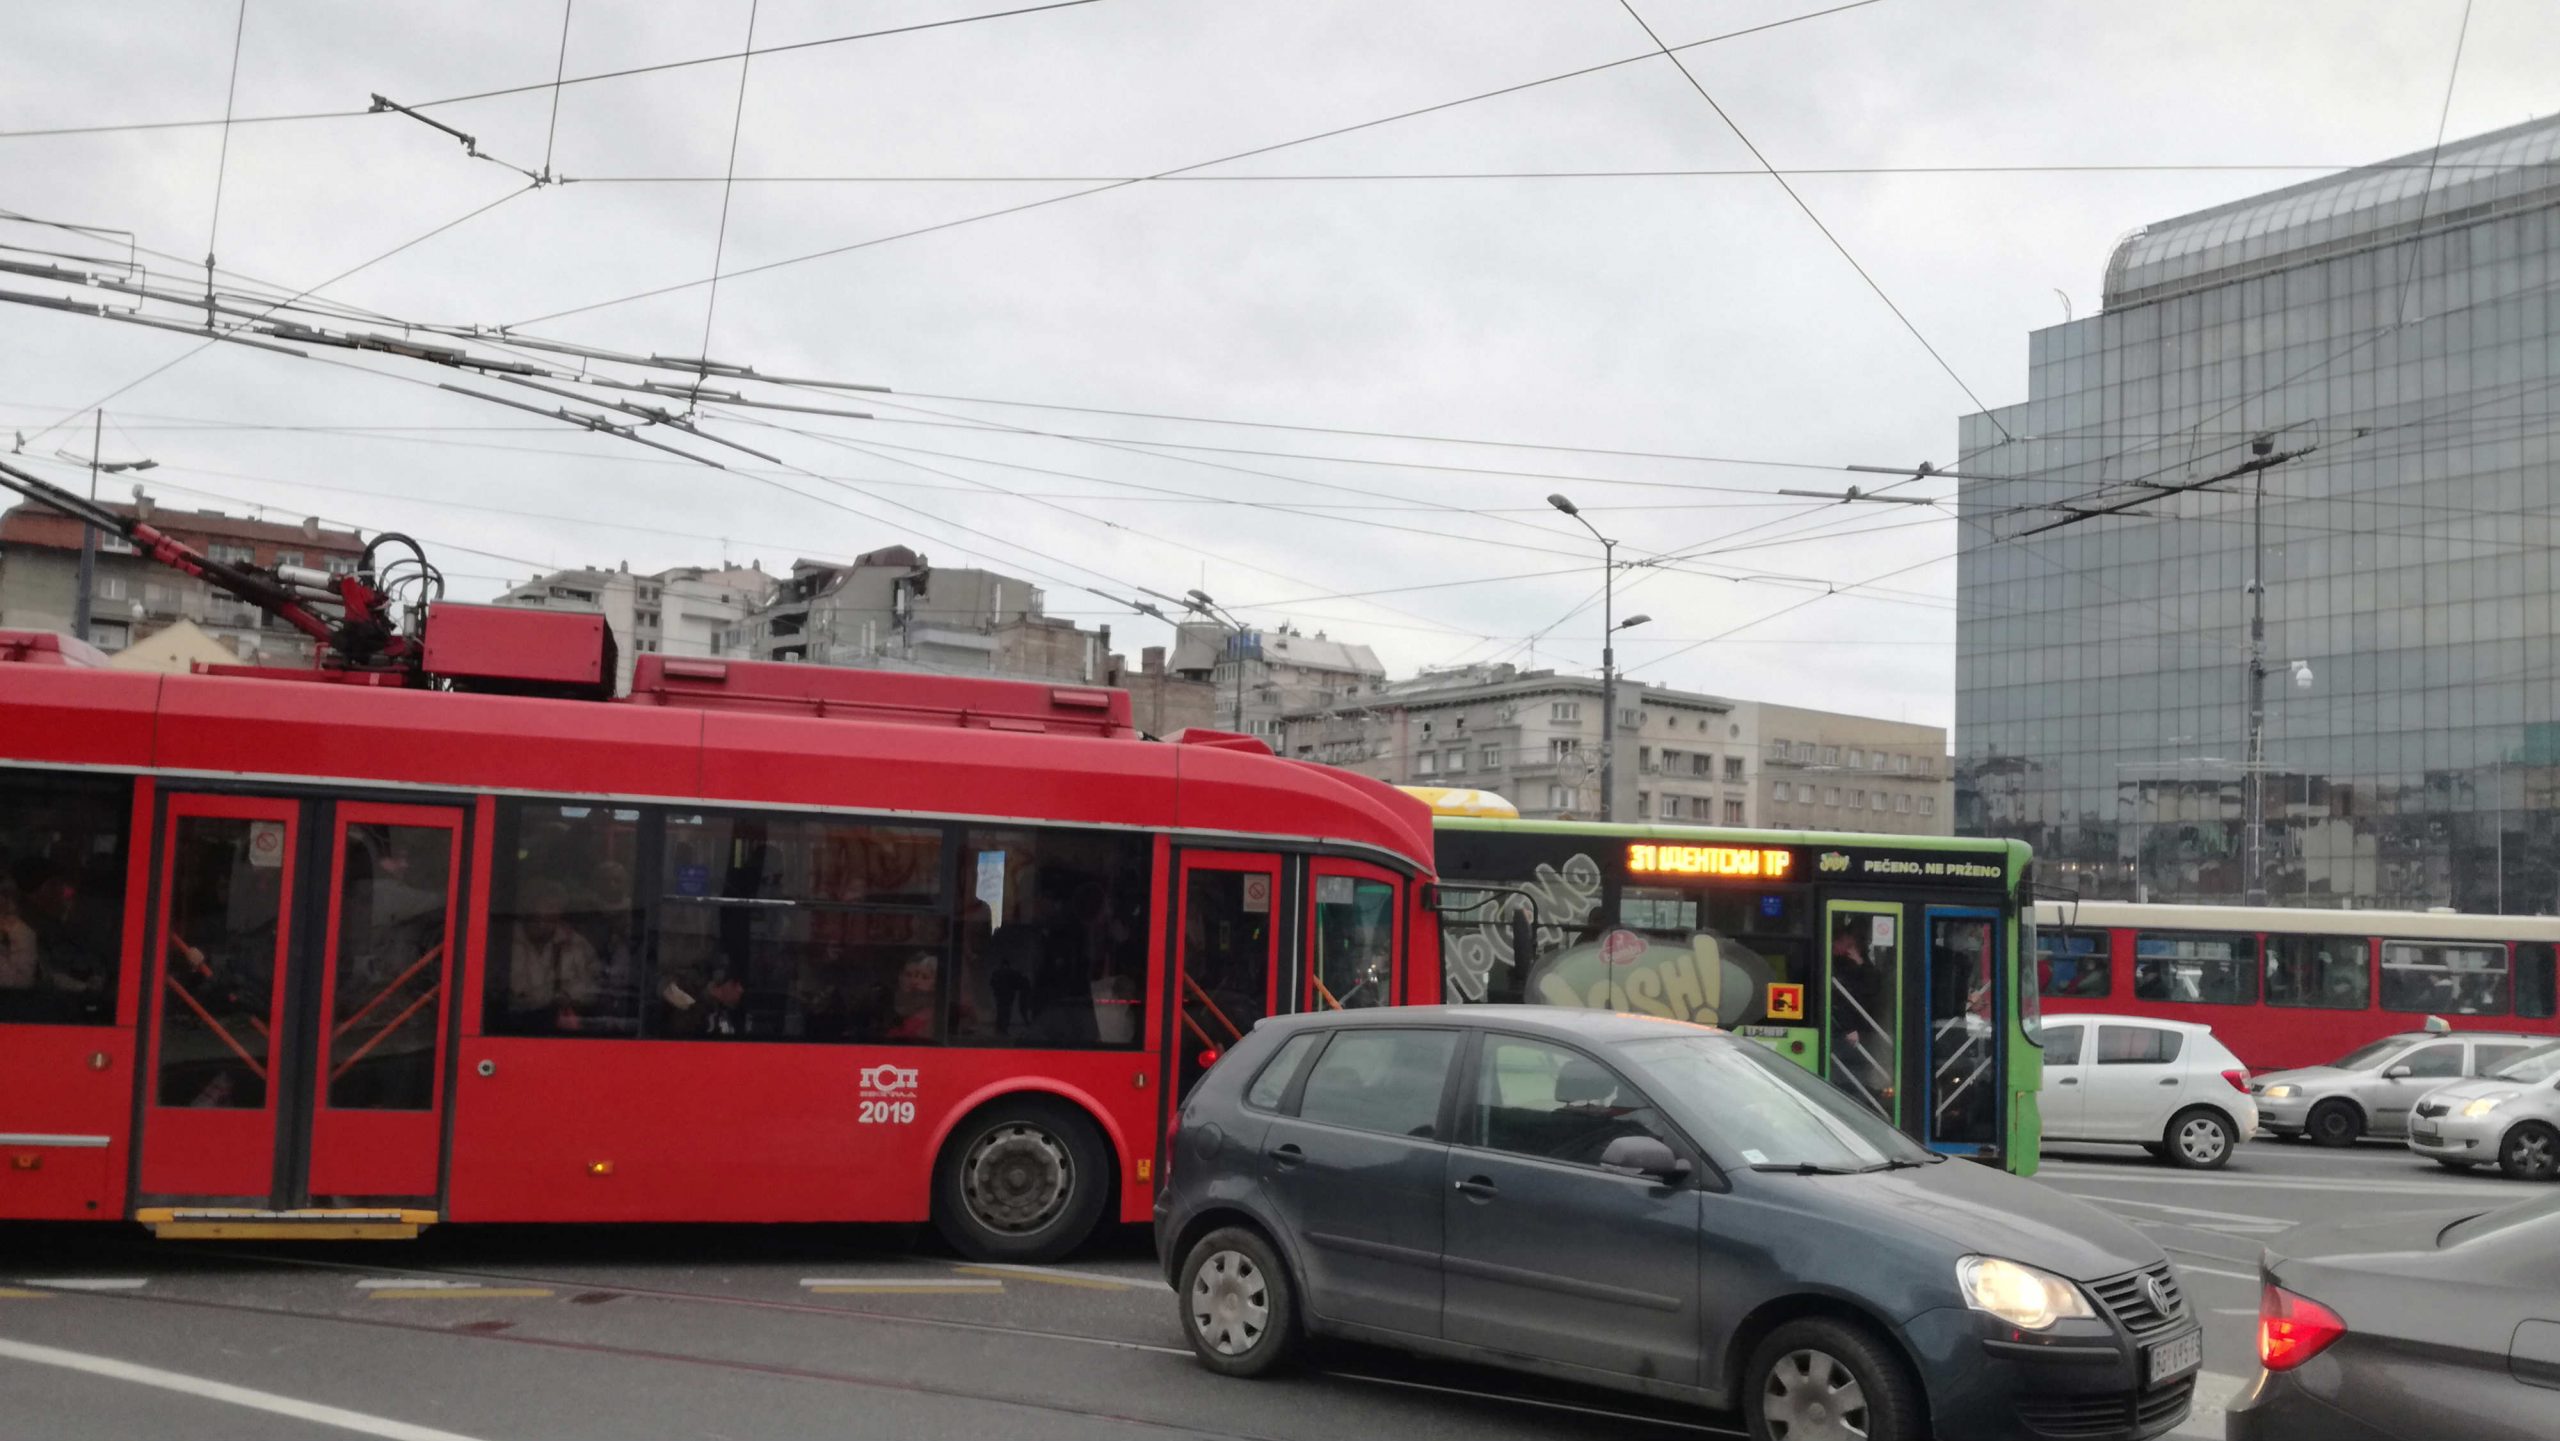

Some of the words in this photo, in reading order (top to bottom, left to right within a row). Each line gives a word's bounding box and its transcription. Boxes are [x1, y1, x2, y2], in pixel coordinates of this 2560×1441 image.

[1631, 845, 1656, 871] 31
[1864, 859, 1923, 875] PEČENO,
[1925, 862, 1944, 875] NE
[1946, 862, 2001, 878] PRŽENO
[859, 1101, 915, 1124] 2019
